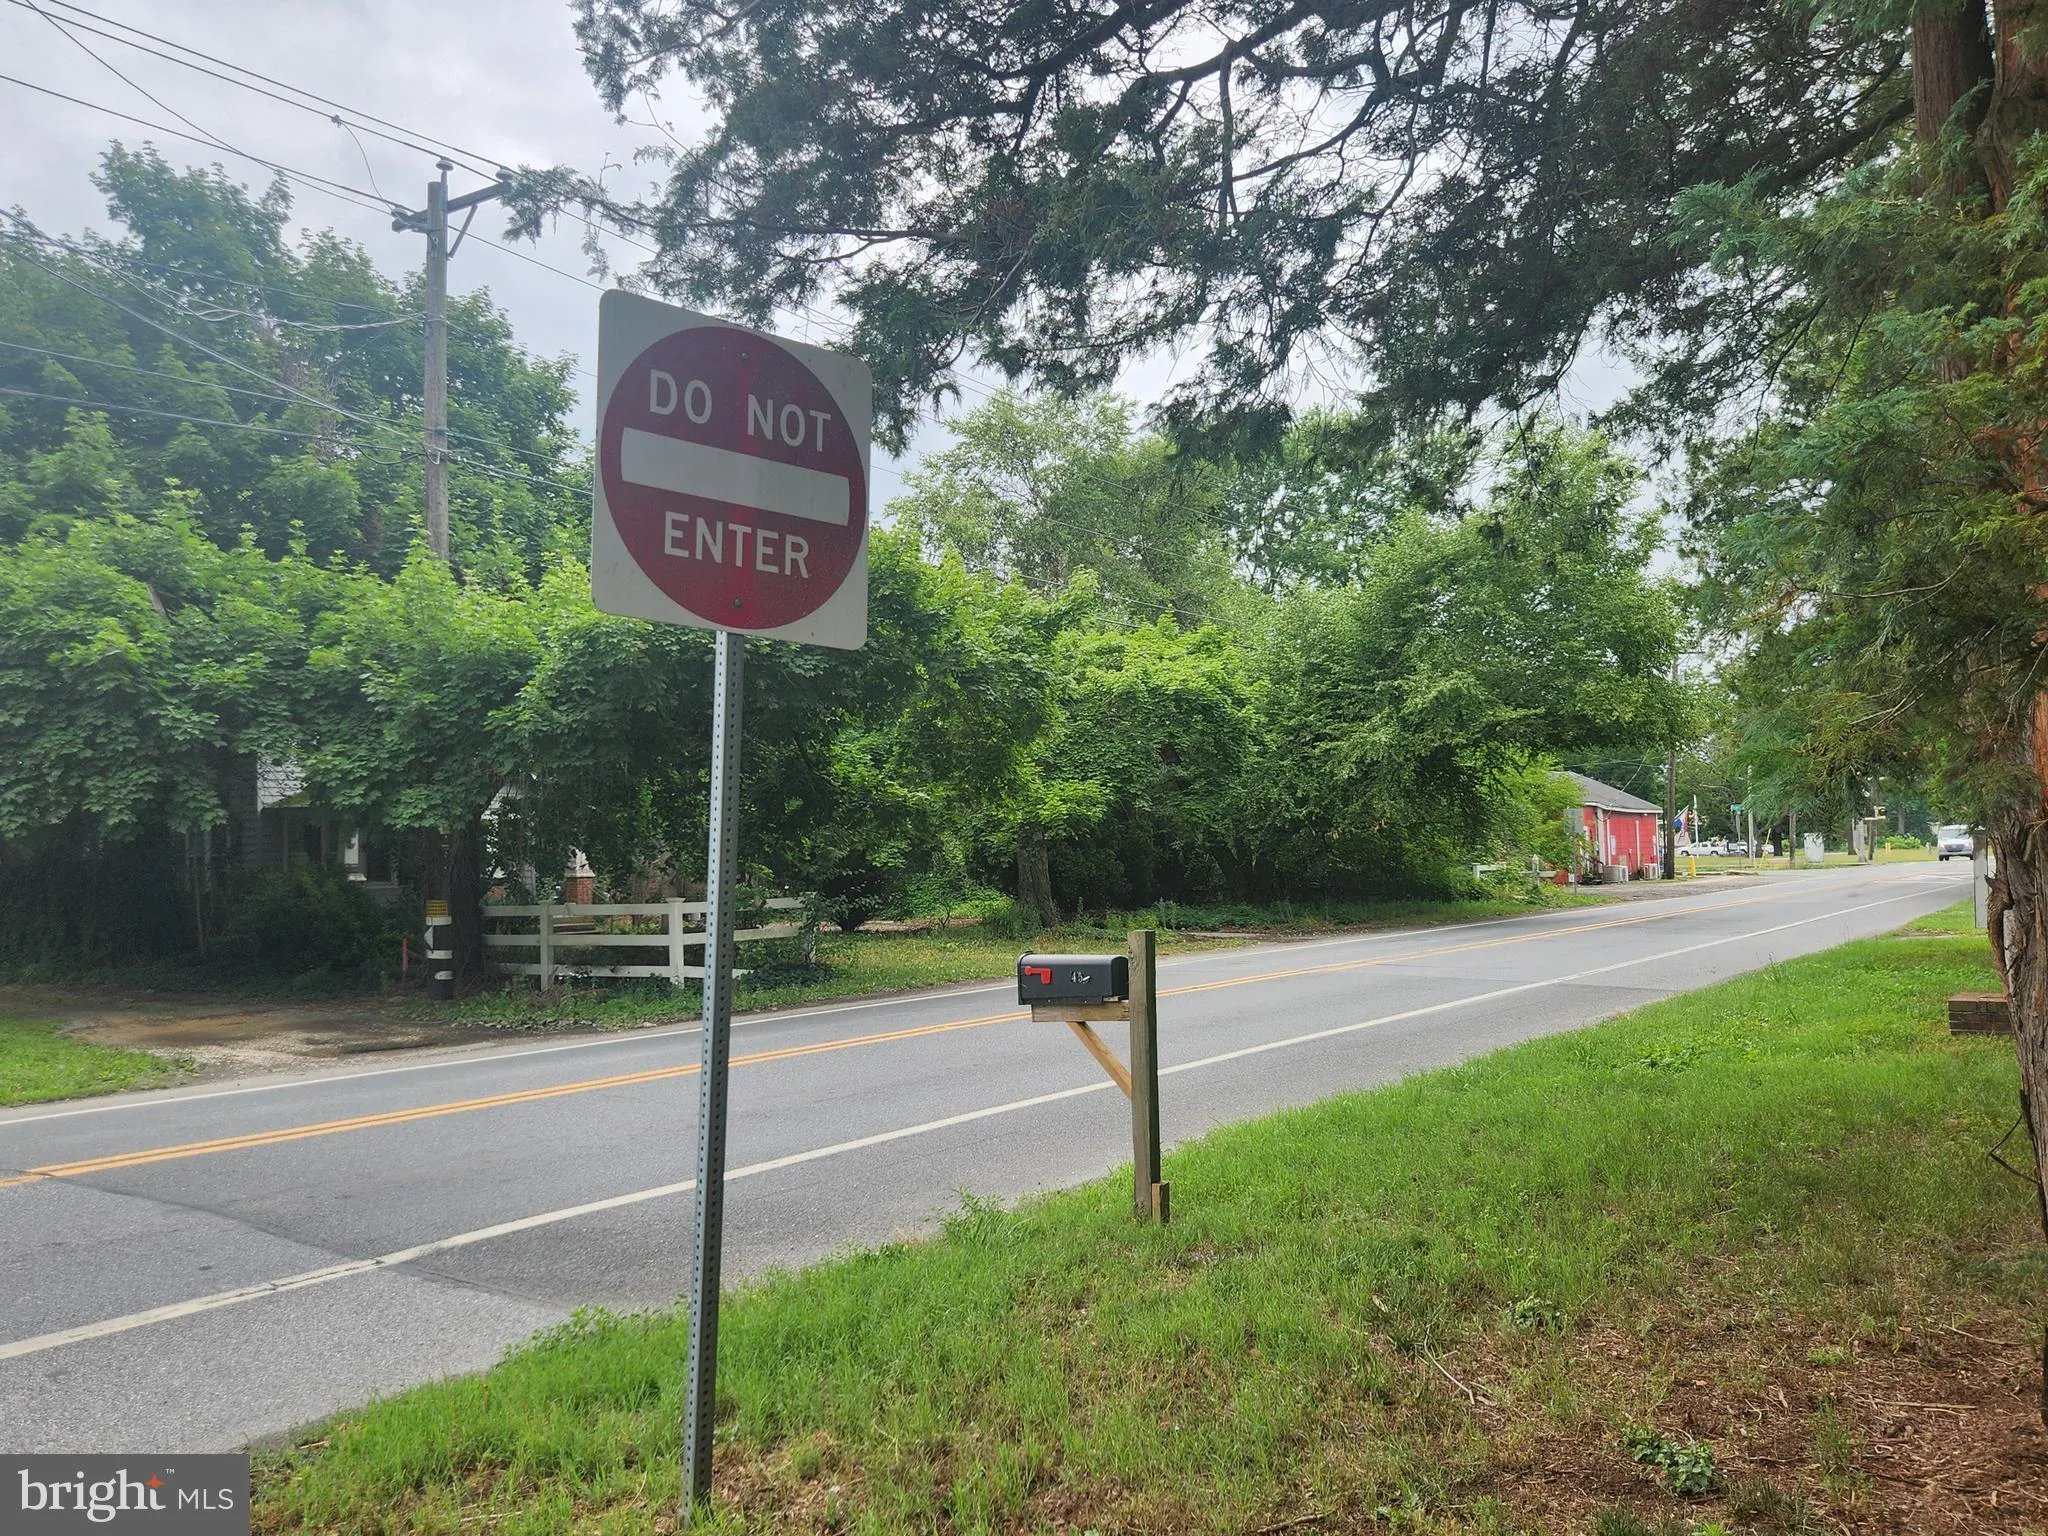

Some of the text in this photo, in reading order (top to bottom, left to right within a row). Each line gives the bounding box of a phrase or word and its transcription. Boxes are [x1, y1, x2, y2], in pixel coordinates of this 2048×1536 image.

[649, 368, 832, 453] DO NOT
[663, 511, 810, 579] ENTER
